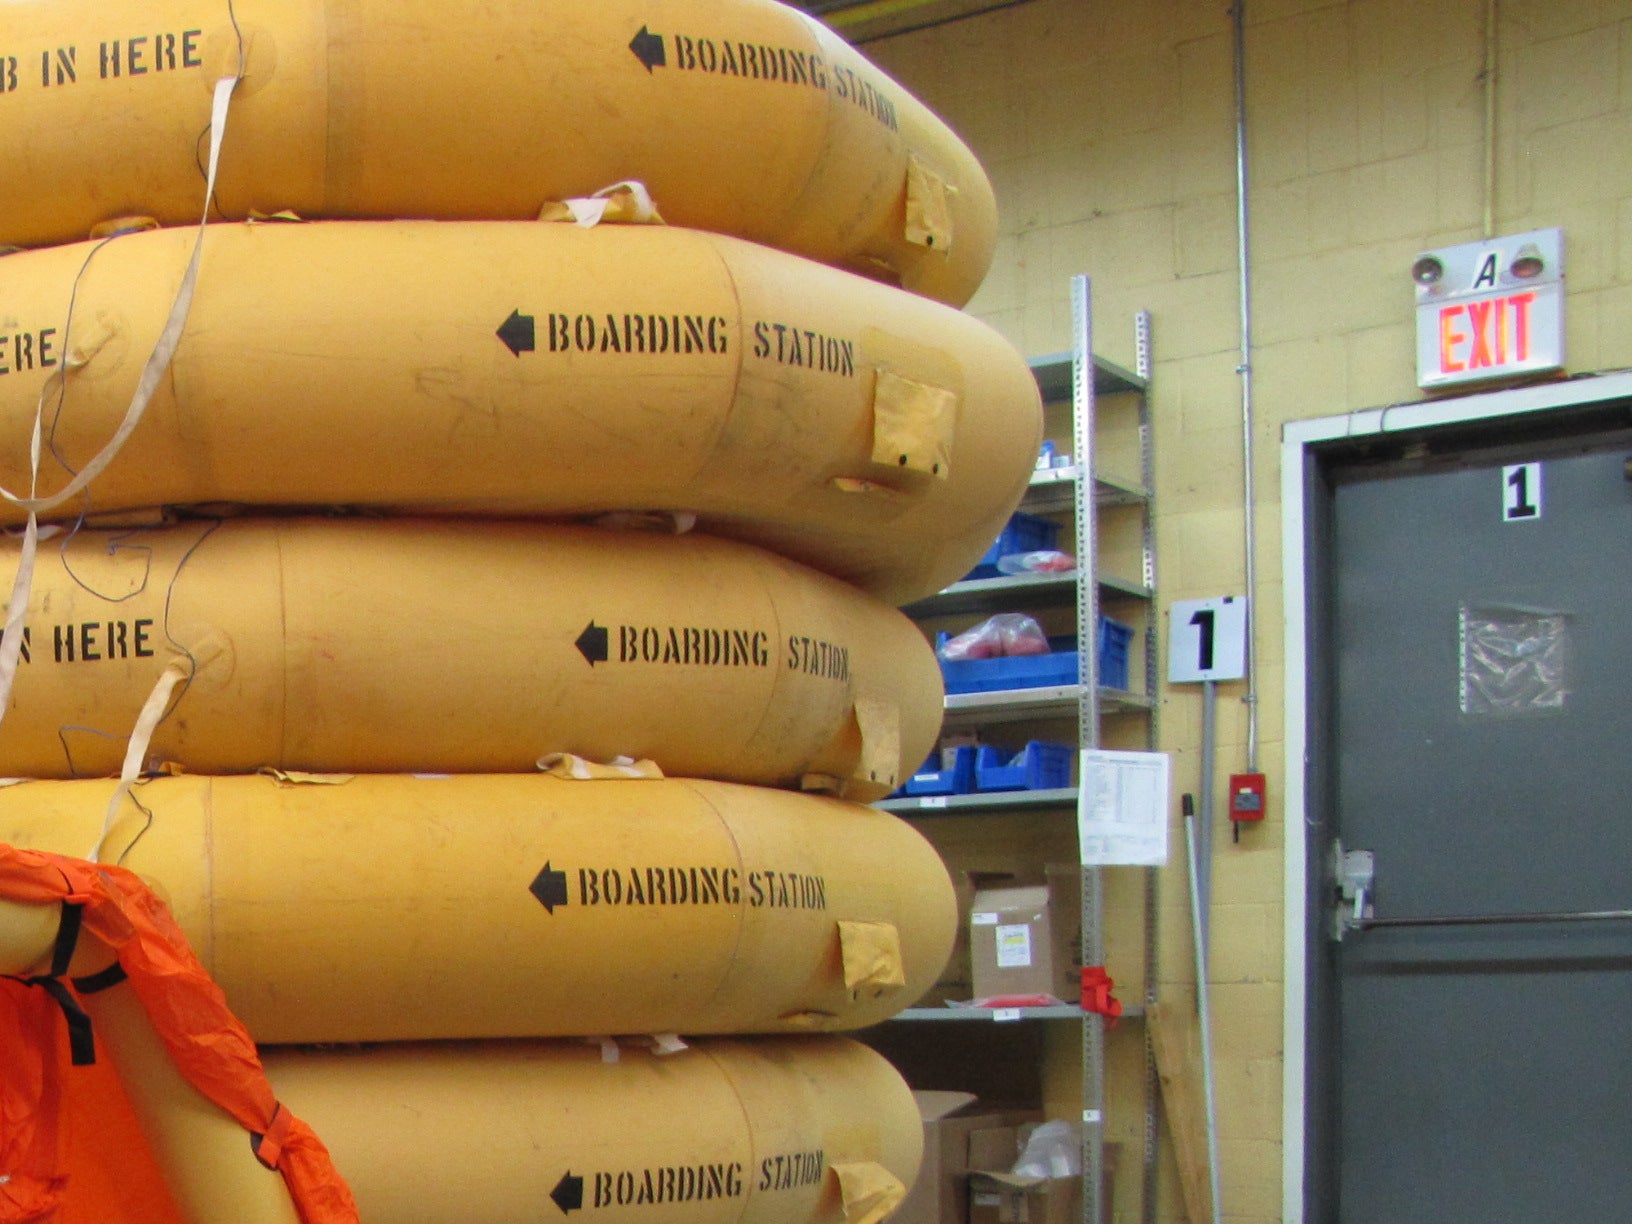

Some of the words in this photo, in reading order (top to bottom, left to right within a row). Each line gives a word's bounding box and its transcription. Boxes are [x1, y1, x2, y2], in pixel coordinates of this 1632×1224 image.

[42, 46, 77, 87] IN
[99, 29, 203, 79] HERE
[675, 34, 826, 90] BOARDING
[835, 64, 900, 134] STATION
[1475, 253, 1498, 289] A
[548, 312, 728, 355] BOARDING
[753, 322, 854, 377] STATION
[1438, 293, 1537, 374] EXIT
[1507, 467, 1536, 518] 1
[54, 619, 154, 663] HERE
[619, 625, 768, 667] BOARDING
[788, 635, 849, 682] STATION
[1189, 610, 1214, 670] 1
[579, 867, 740, 905] BOARDING
[749, 870, 826, 910] STATION
[594, 1162, 742, 1208] BOARDING
[759, 1149, 824, 1192] STATION
